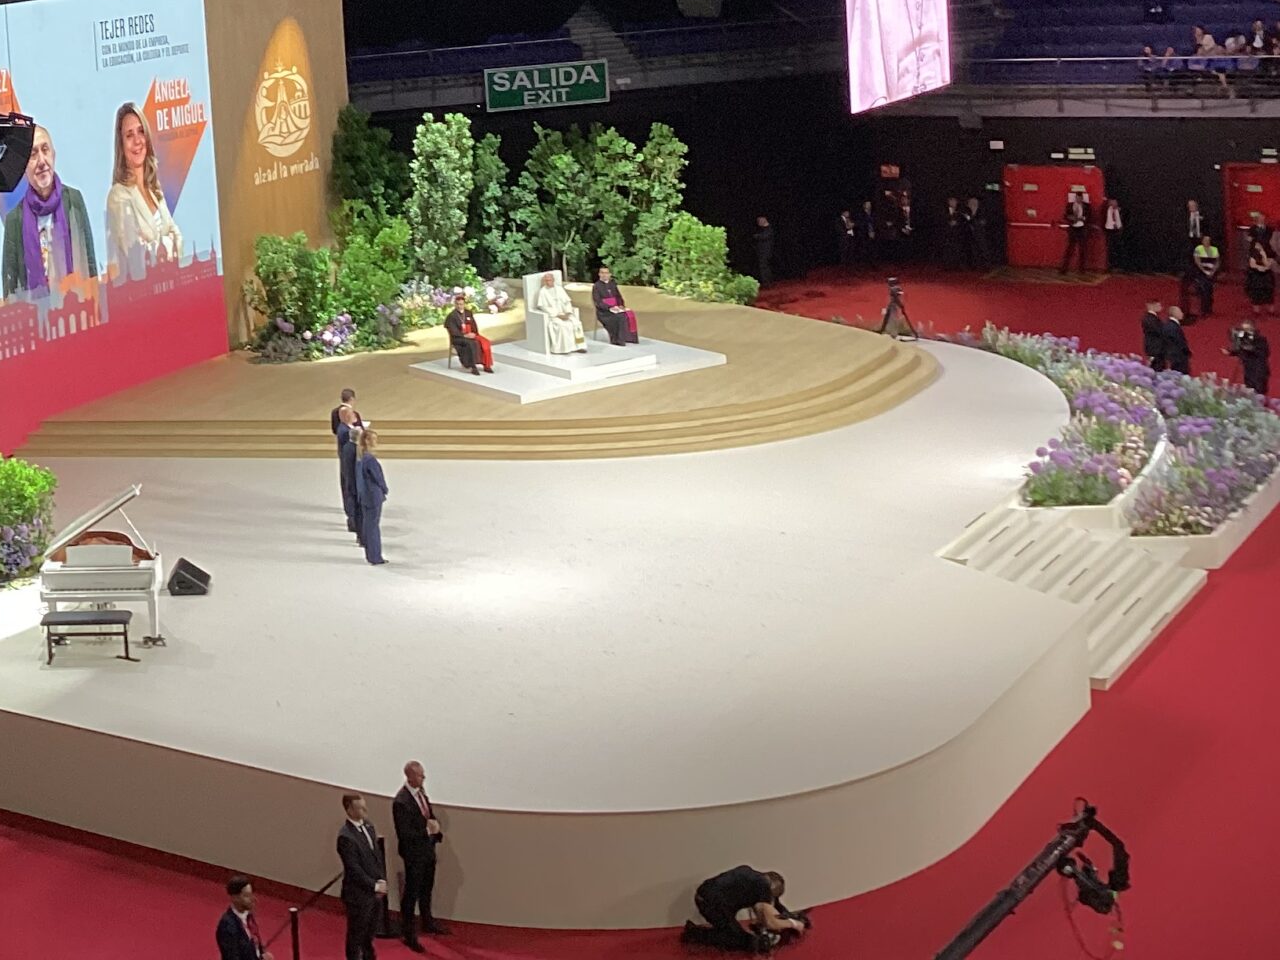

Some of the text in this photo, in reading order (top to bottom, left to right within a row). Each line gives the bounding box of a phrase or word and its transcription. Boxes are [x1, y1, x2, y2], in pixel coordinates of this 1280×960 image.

[100, 13, 155, 40] TEJER REDES
[492, 65, 599, 91] SALIDA
[523, 87, 570, 105] EXIT
[156, 104, 208, 131] DE MIGUEL
